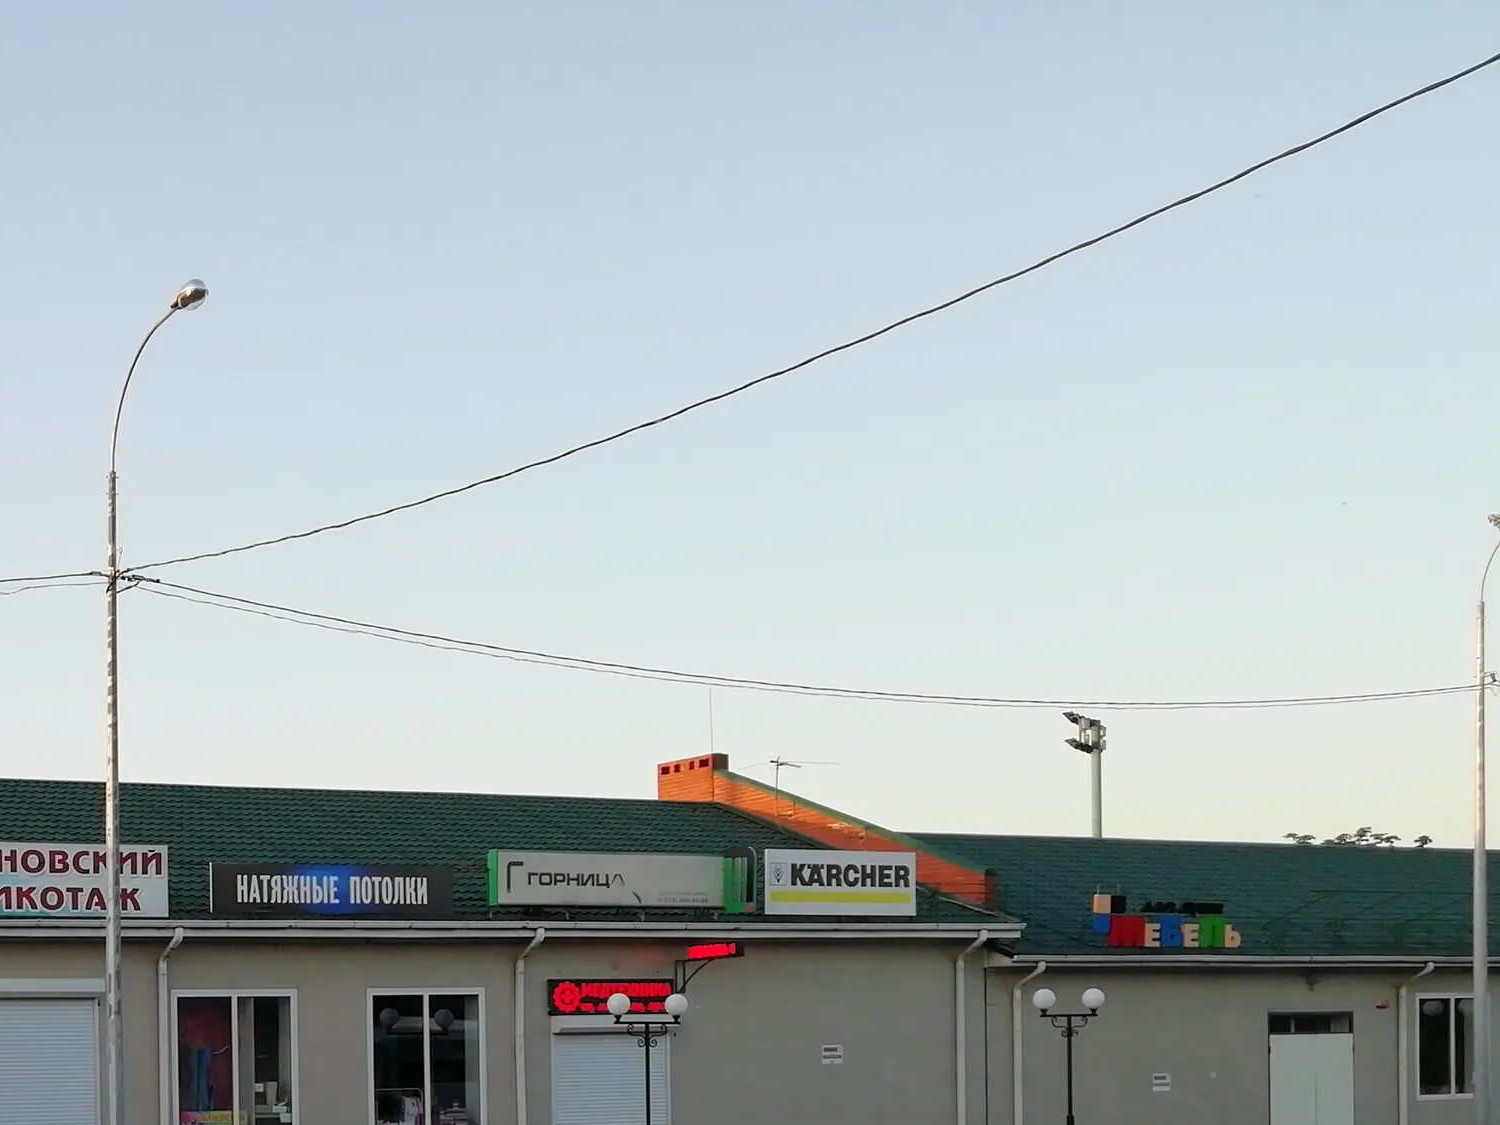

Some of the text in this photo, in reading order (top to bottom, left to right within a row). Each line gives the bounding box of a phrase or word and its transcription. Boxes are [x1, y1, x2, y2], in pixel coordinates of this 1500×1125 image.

[236, 874, 429, 905] НАТЯЖНЫЕ ПОТОЛКИ
[791, 863, 911, 888] KÄRCHER
